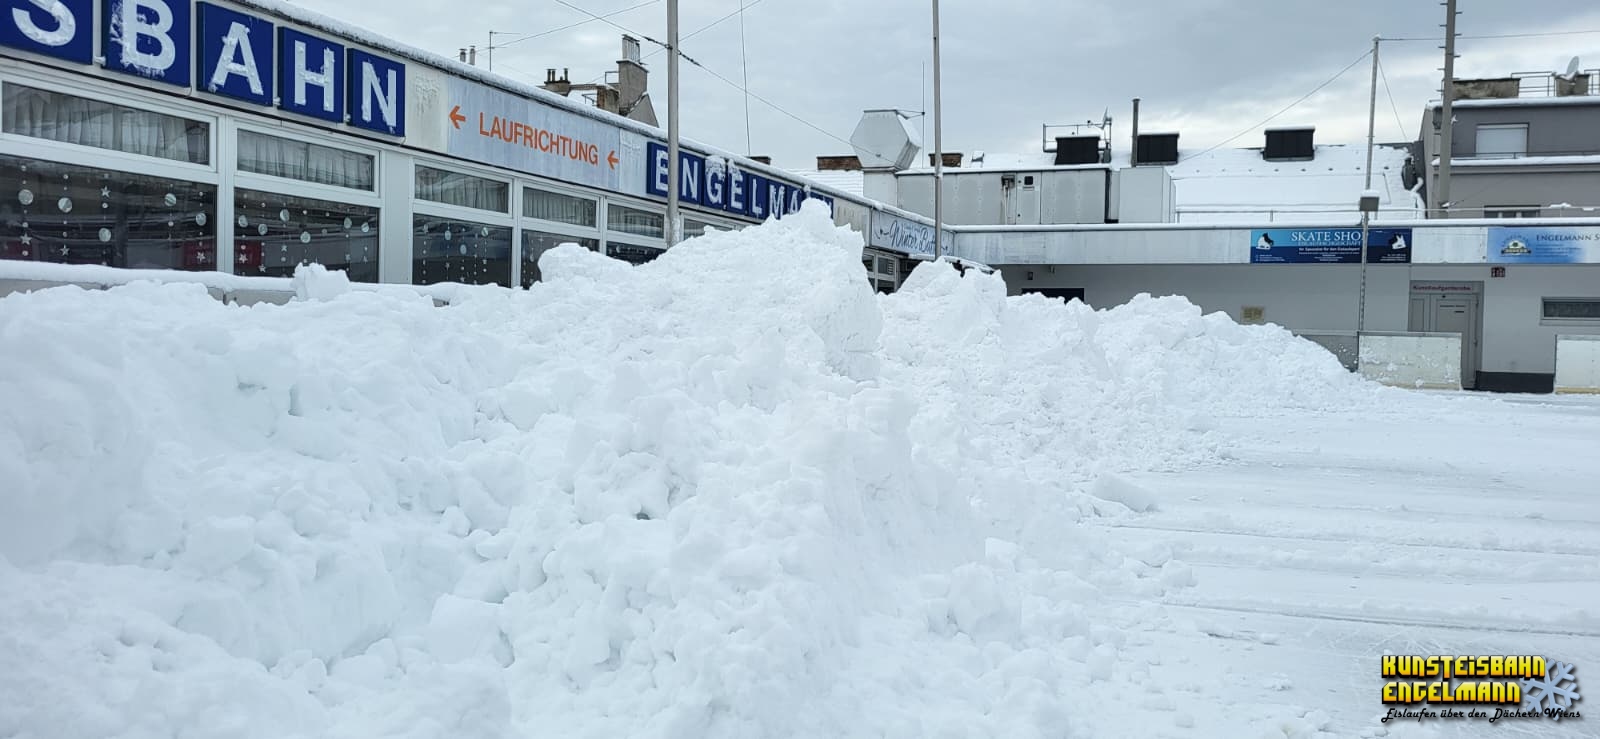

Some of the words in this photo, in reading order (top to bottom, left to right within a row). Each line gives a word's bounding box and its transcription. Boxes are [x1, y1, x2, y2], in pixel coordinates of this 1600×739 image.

[479, 112, 599, 167] LAUFRICHTUNG
[1291, 231, 1332, 241] SKATE
[1334, 231, 1367, 241] SHO
